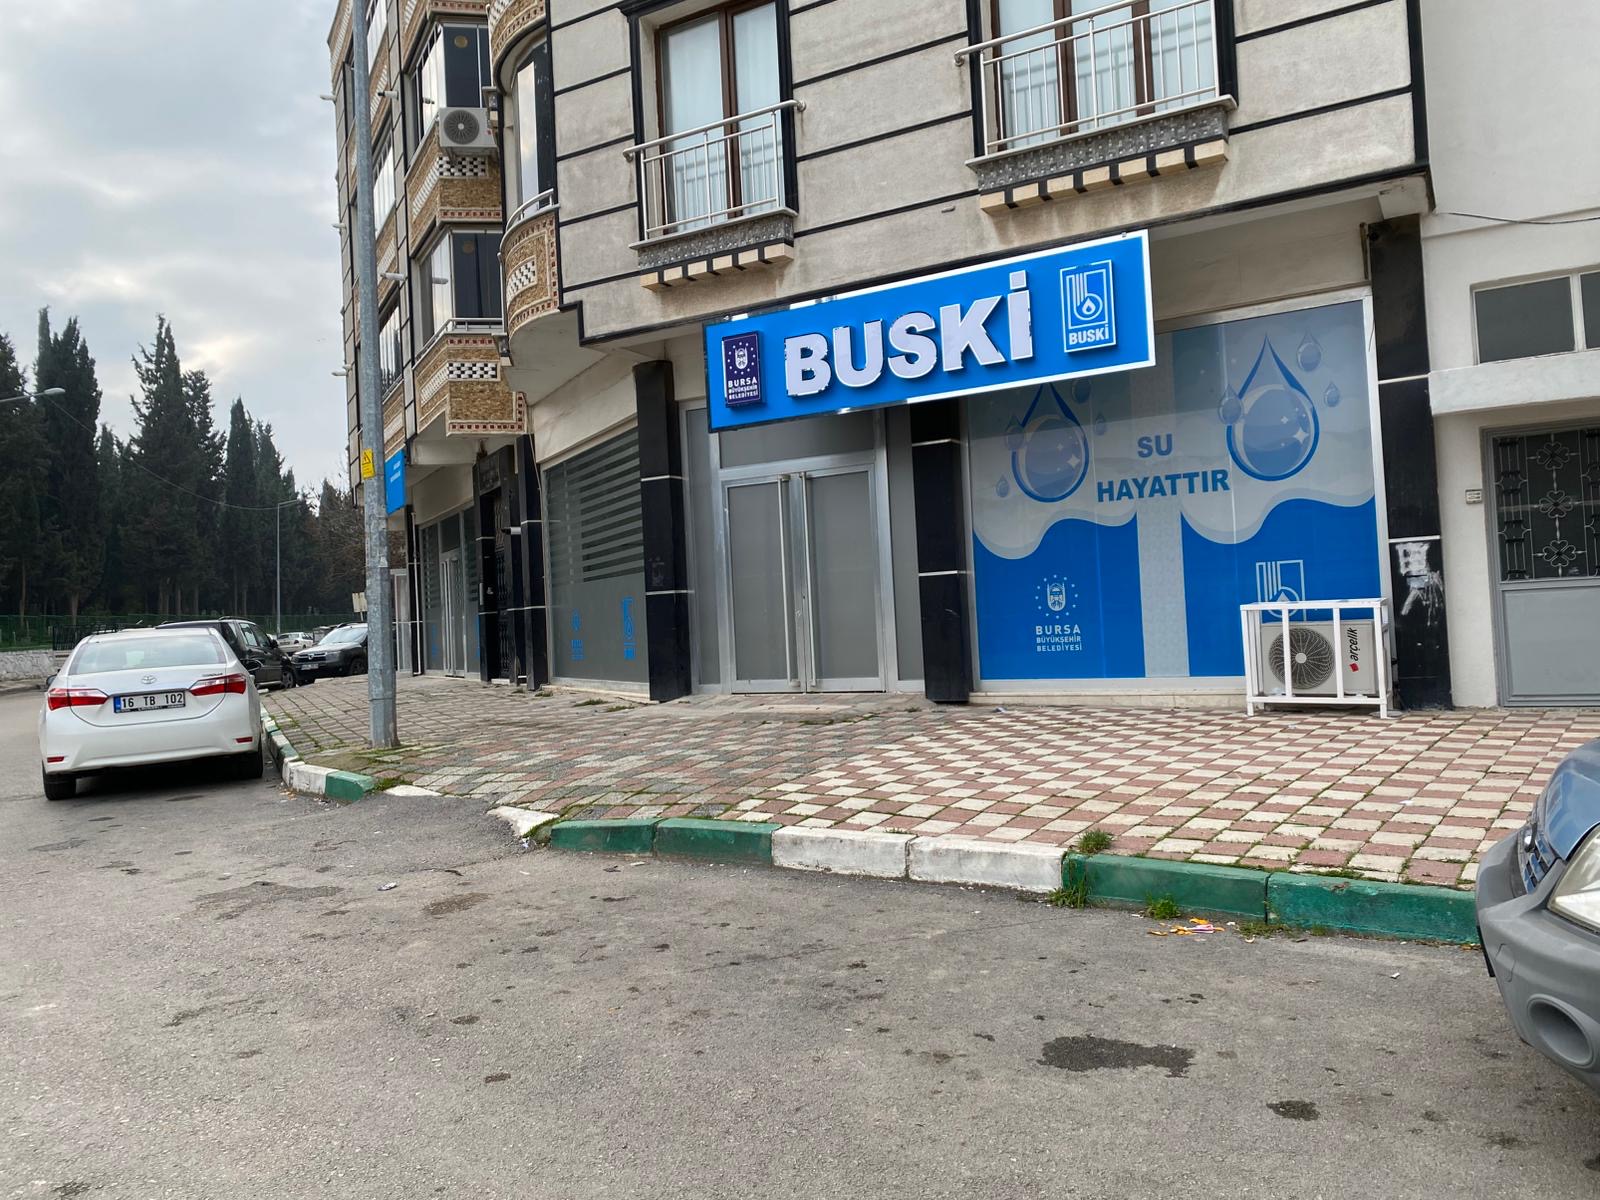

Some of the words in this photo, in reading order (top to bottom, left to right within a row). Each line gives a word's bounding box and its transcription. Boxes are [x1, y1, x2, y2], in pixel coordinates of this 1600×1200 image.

[785, 270, 1033, 396] BUSKİ
[1068, 323, 1110, 346] BUSKİ
[727, 376, 758, 388] BURSA
[1137, 433, 1173, 458] SU
[1097, 469, 1230, 502] HAYATTIR
[1035, 624, 1081, 635] BURSA
[1346, 627, 1361, 662] arçelik
[121, 697, 135, 708] 16
[165, 693, 183, 704] 102
